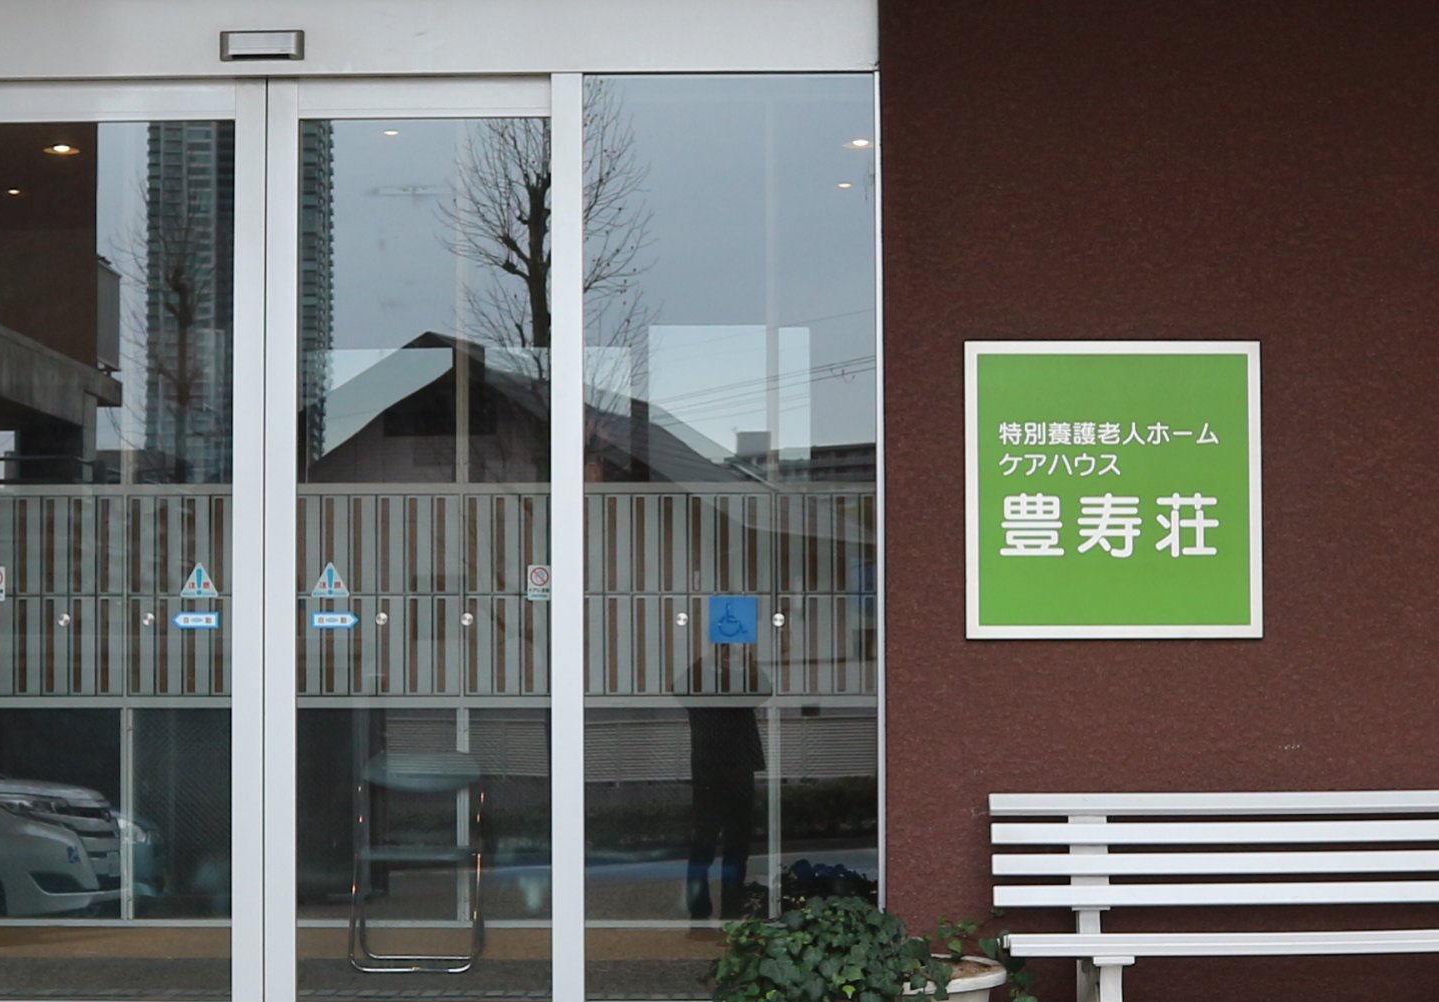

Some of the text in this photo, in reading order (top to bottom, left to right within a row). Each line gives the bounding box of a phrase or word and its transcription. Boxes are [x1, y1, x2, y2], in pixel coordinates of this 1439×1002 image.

[999, 422, 1219, 445] 特別養護老人ホーム
[999, 453, 1121, 476] ケアハウス
[1000, 492, 1219, 558] 豊寿荘
